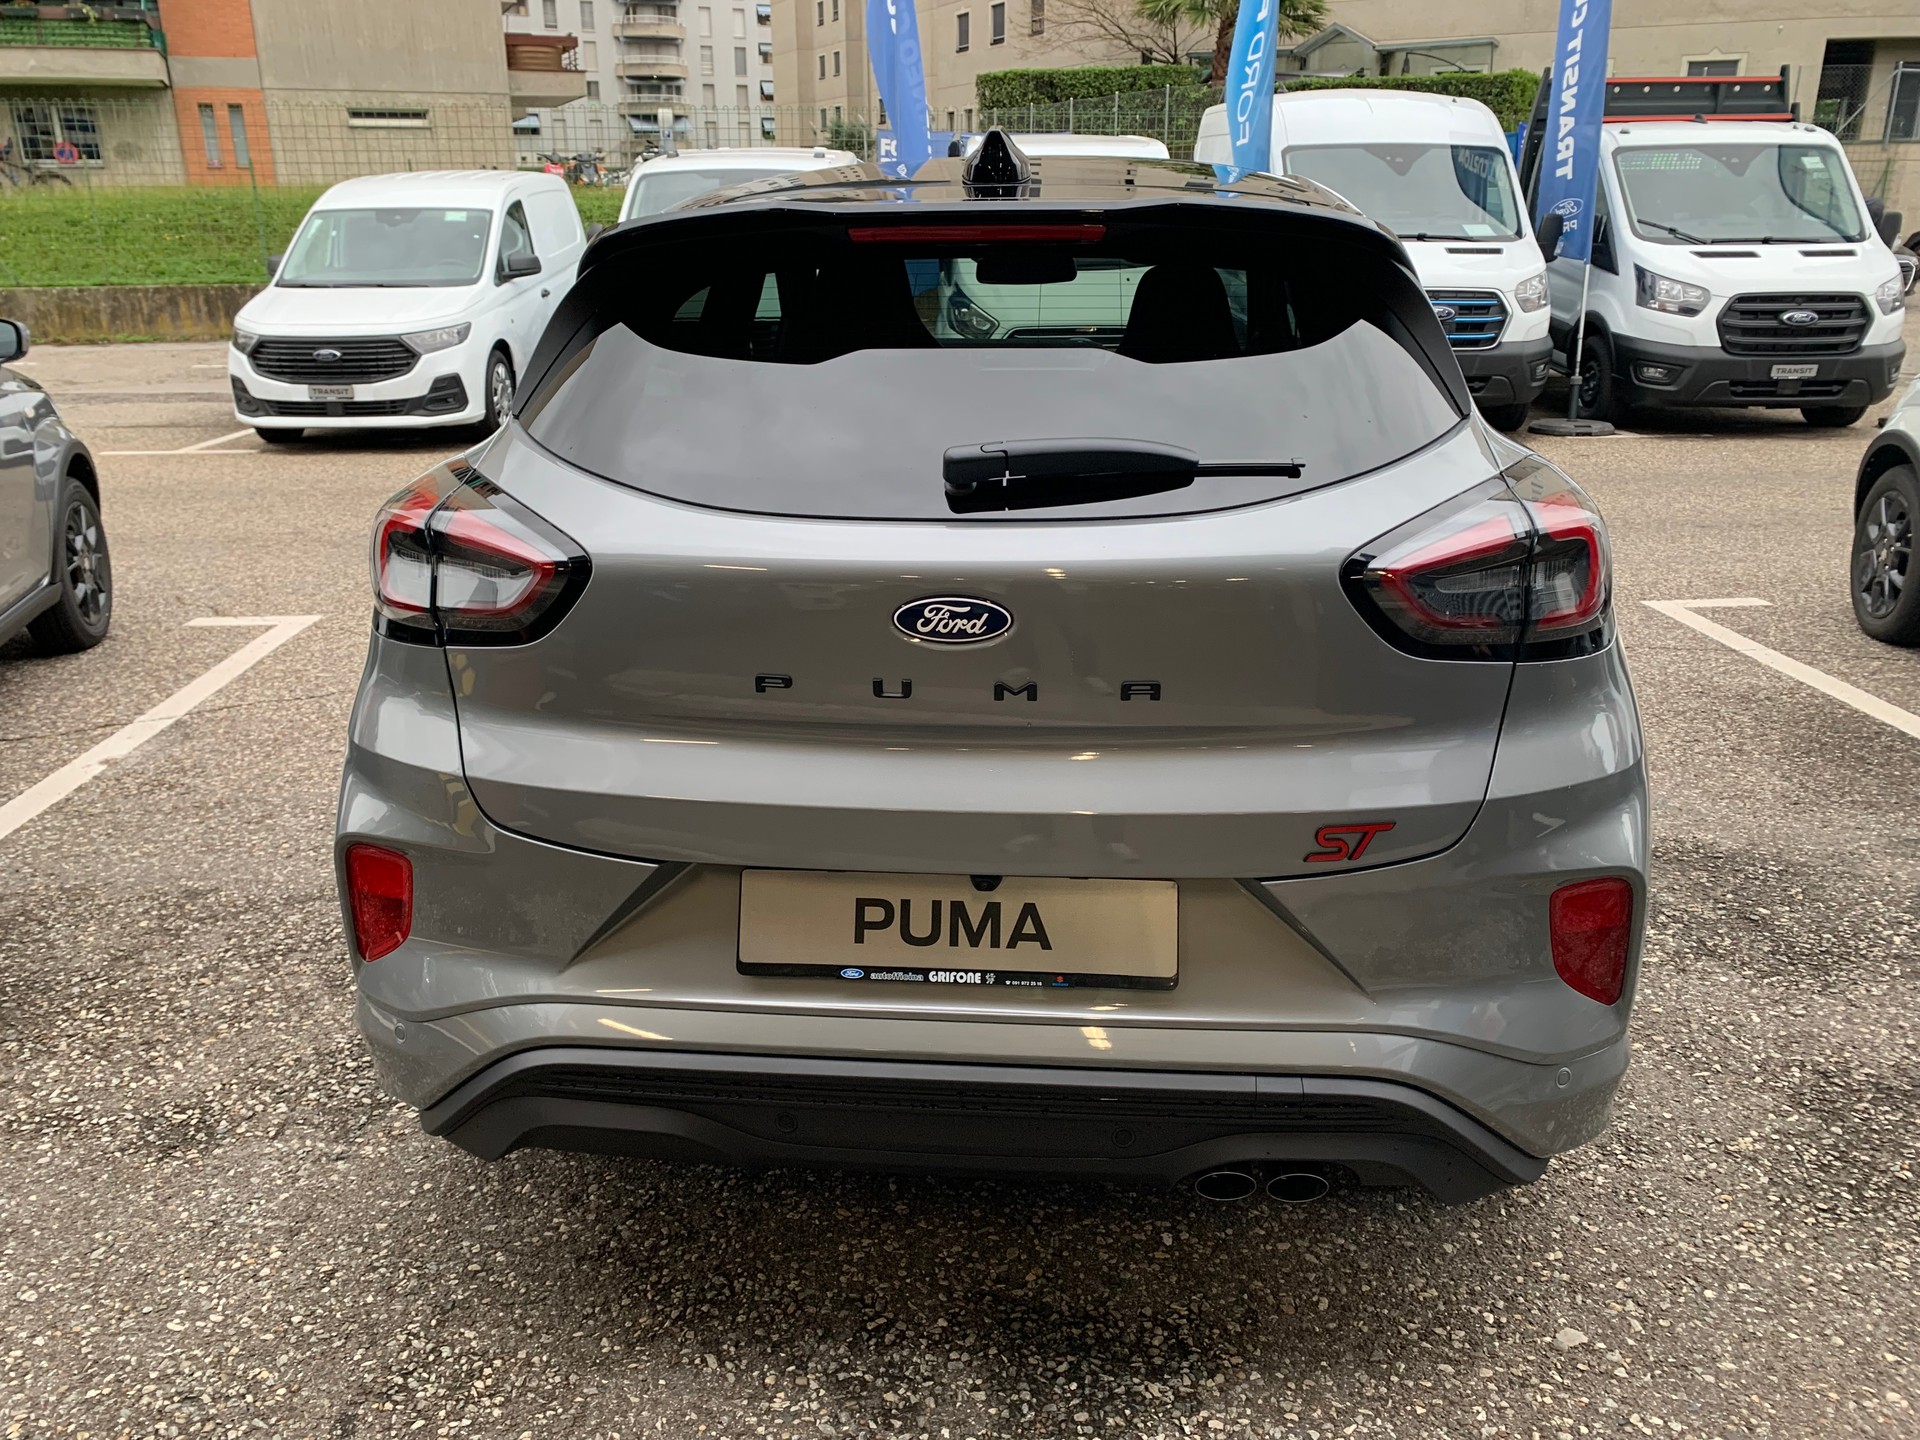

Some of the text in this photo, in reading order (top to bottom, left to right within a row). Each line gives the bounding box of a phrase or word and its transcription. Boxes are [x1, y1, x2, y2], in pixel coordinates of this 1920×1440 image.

[916, 604, 988, 636] Ford
[755, 672, 1161, 701] PUMA
[1303, 821, 1396, 863] ST
[854, 897, 1053, 951] PUMA
[870, 971, 924, 982] autofficina
[928, 971, 982, 984] GRIFONE
